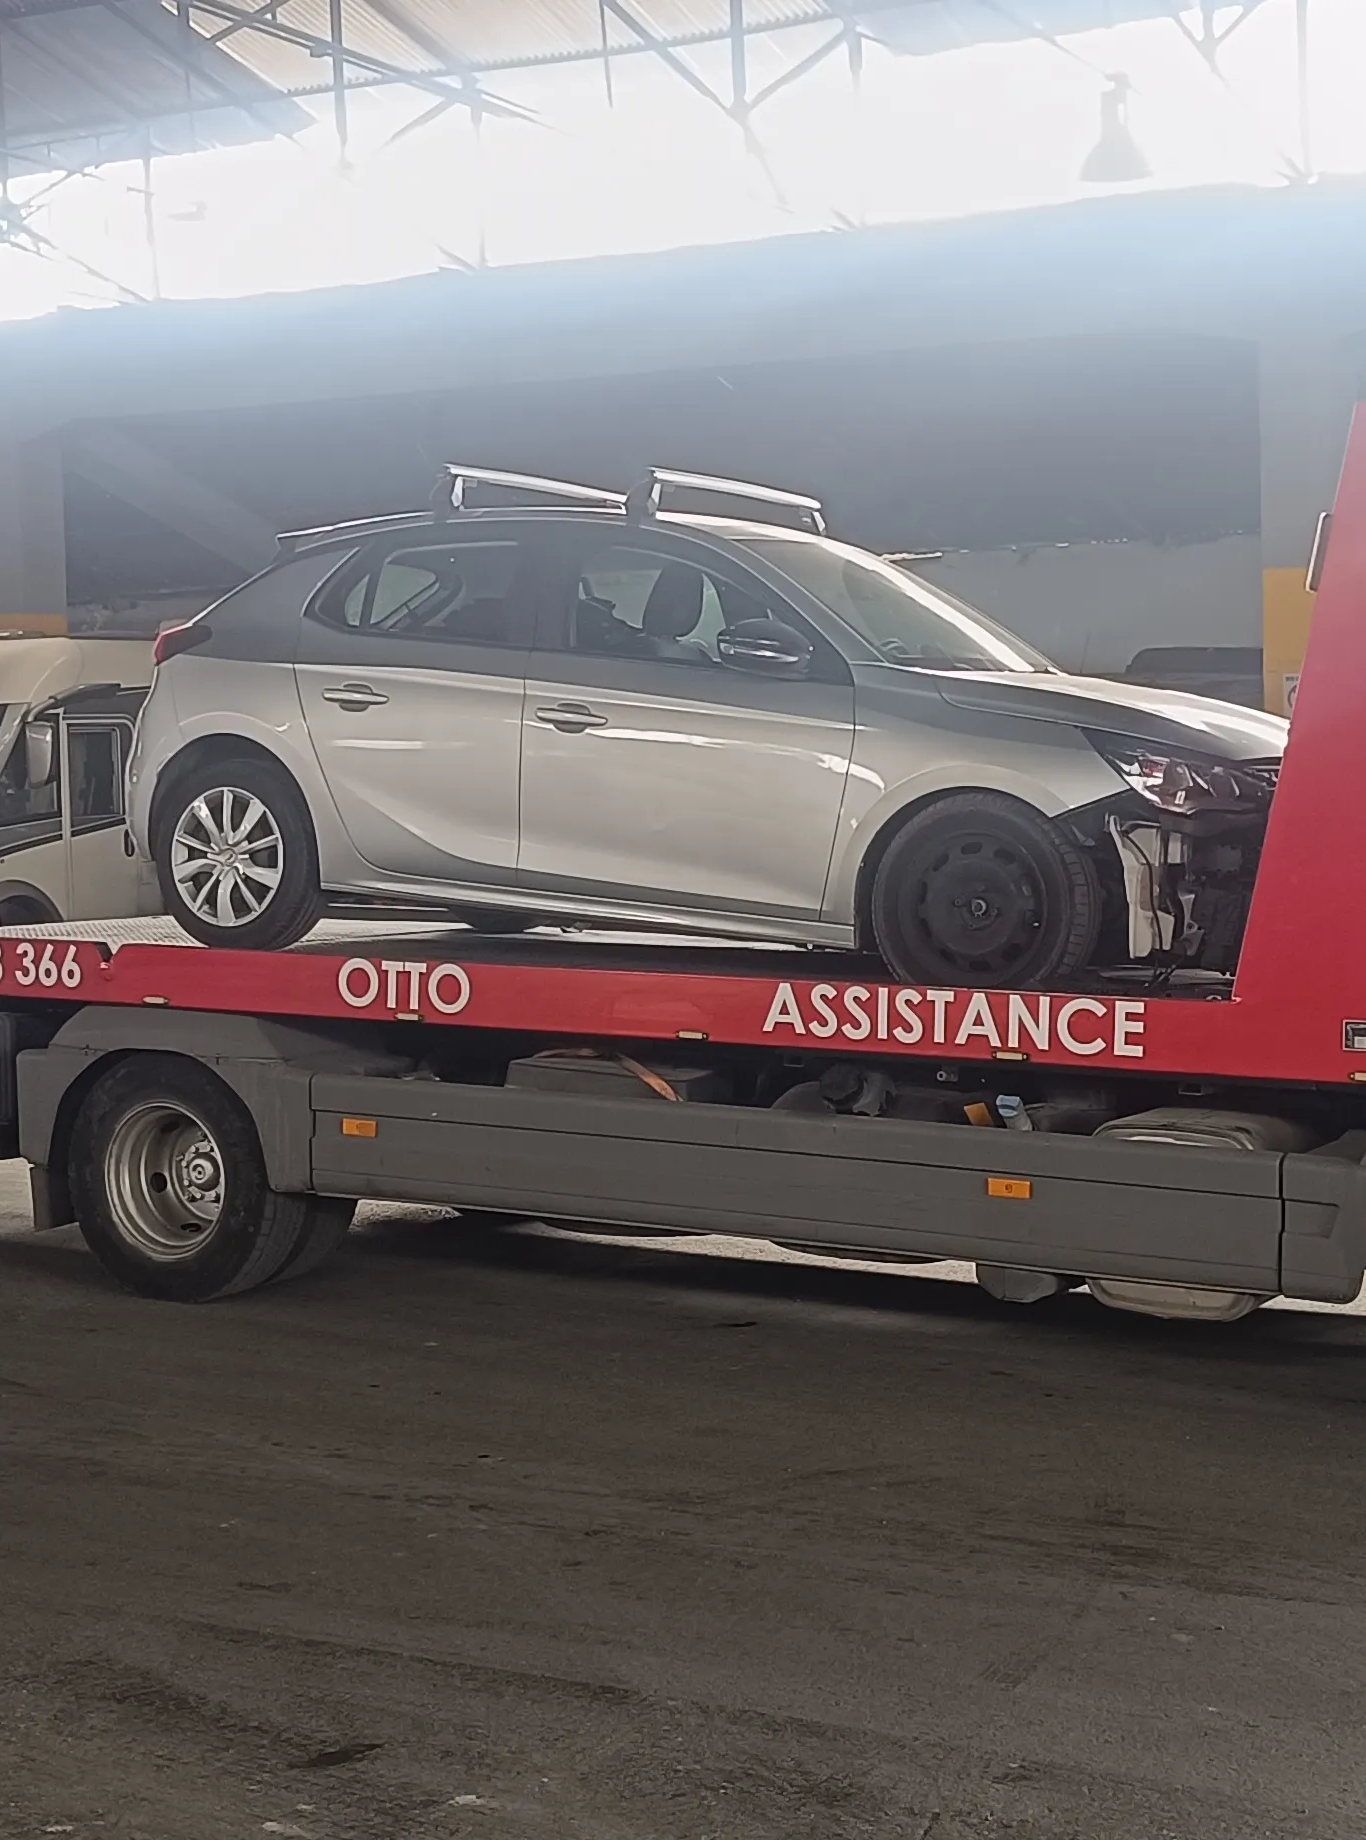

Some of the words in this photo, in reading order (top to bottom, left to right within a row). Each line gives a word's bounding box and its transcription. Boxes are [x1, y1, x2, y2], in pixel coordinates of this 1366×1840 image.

[14, 942, 81, 988] 366
[338, 957, 470, 1014] OTTO
[763, 982, 1146, 1058] ASSISTANCE
